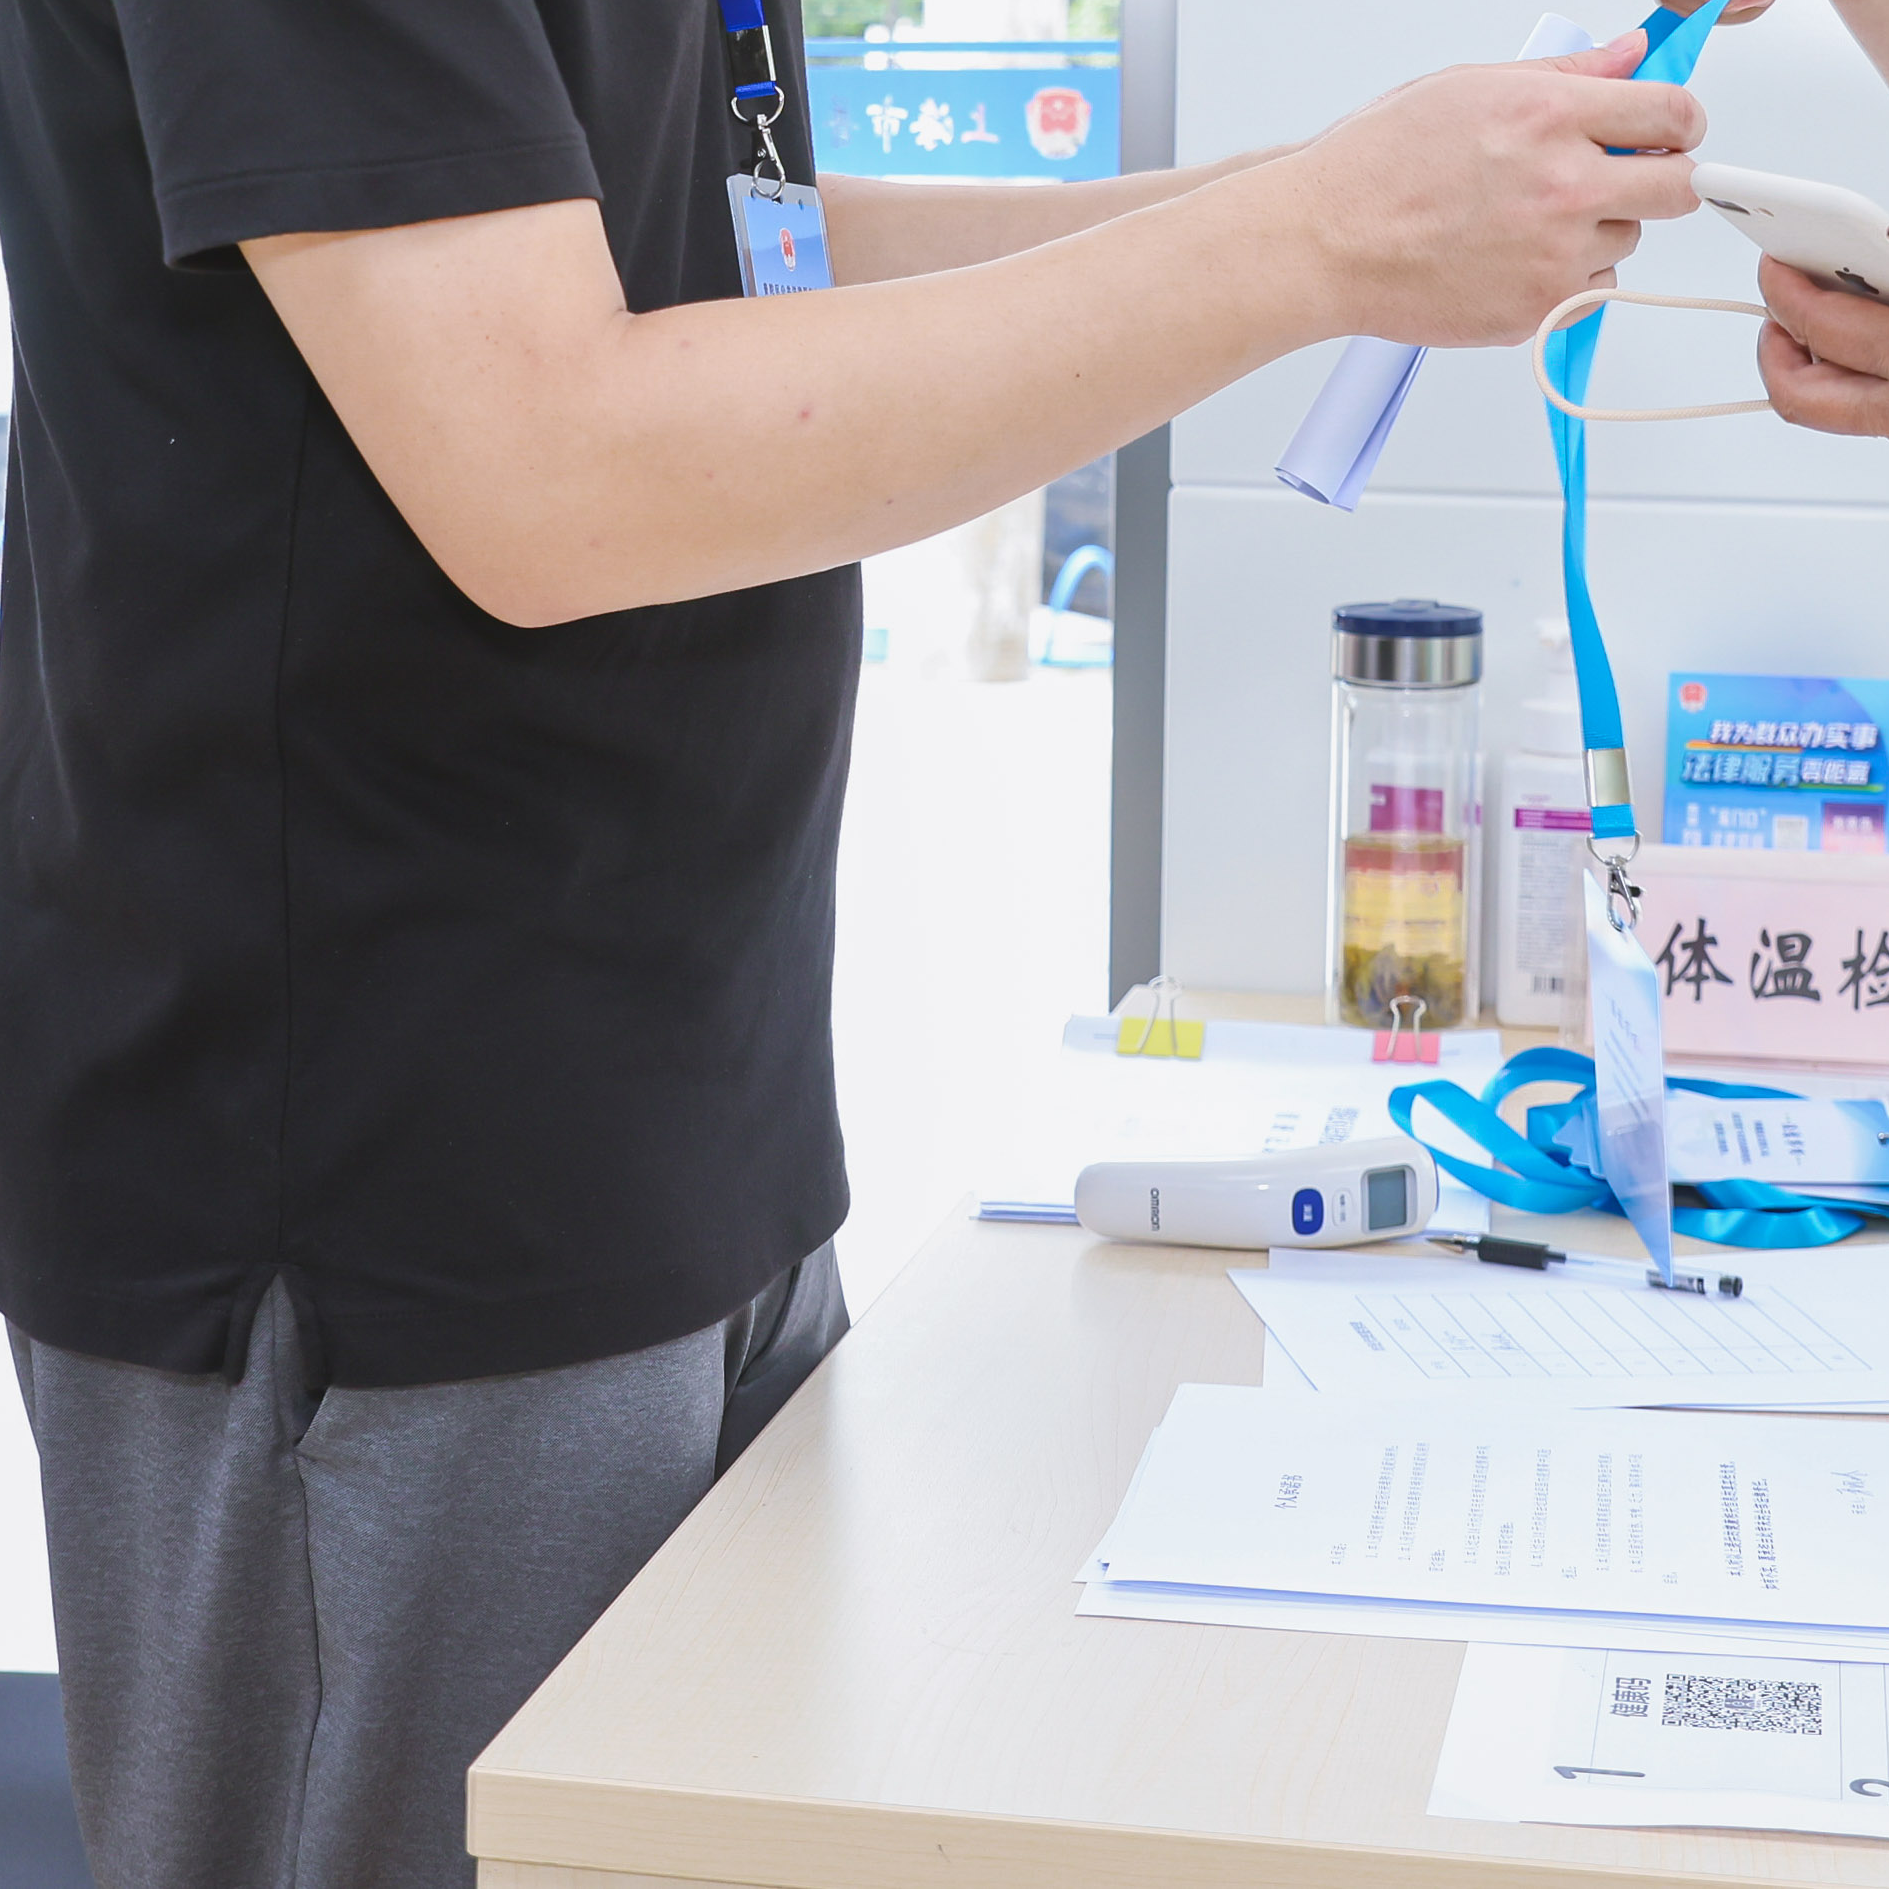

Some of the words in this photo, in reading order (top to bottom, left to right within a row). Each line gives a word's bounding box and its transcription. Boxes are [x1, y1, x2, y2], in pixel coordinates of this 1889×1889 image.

[1608, 1675, 1653, 1718] 健康码
[1552, 1764, 1646, 1780] 1
